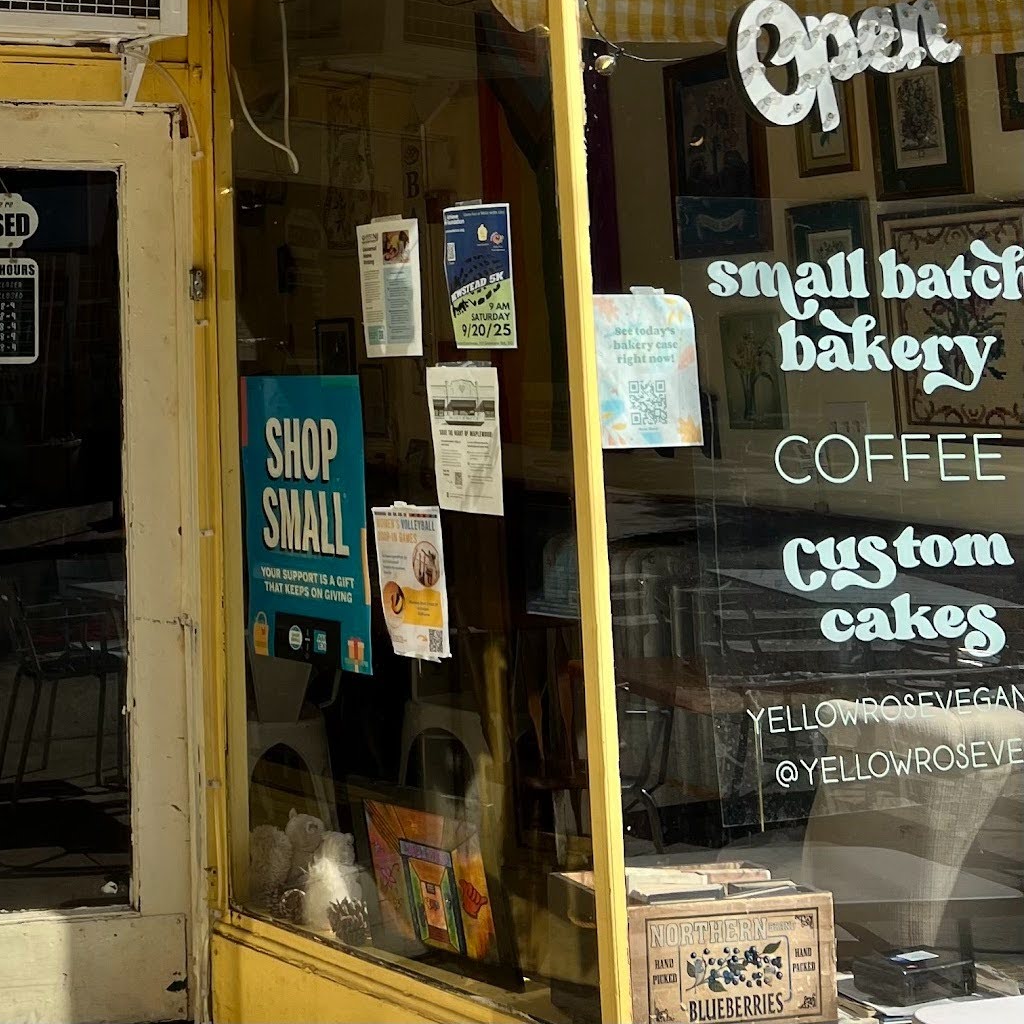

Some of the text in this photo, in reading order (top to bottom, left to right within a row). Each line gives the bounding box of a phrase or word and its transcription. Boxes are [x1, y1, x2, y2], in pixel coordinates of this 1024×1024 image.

[489, 271, 504, 284] 5K
[707, 239, 1024, 321] small batch
[488, 302, 511, 311] 9 AM
[471, 312, 511, 322] SATURDAY
[462, 323, 511, 338] 9/20/25
[614, 326, 676, 338] See today's
[613, 340, 678, 352] bakery case
[778, 308, 997, 395] bakery
[617, 354, 675, 367] right now!
[265, 417, 338, 481] SHOP
[774, 433, 1007, 485] COFFEE
[262, 486, 350, 557] SMALL
[400, 519, 435, 532] VOLLEYBALL
[782, 526, 1015, 592] custom
[261, 565, 355, 589] YOUR SUPPORT IS A GIFT
[264, 581, 353, 604] THAT KEEPS ON GIVING
[819, 592, 1007, 659] cakes
[775, 737, 1024, 788] @YELLOWROSEVE
[649, 916, 768, 948] NORTHERN
[794, 947, 812, 958] HAND
[654, 959, 674, 970] HAND
[792, 961, 816, 973] PACKED
[653, 973, 678, 985] PICKED
[689, 992, 784, 1023] BLUEBERRIES
